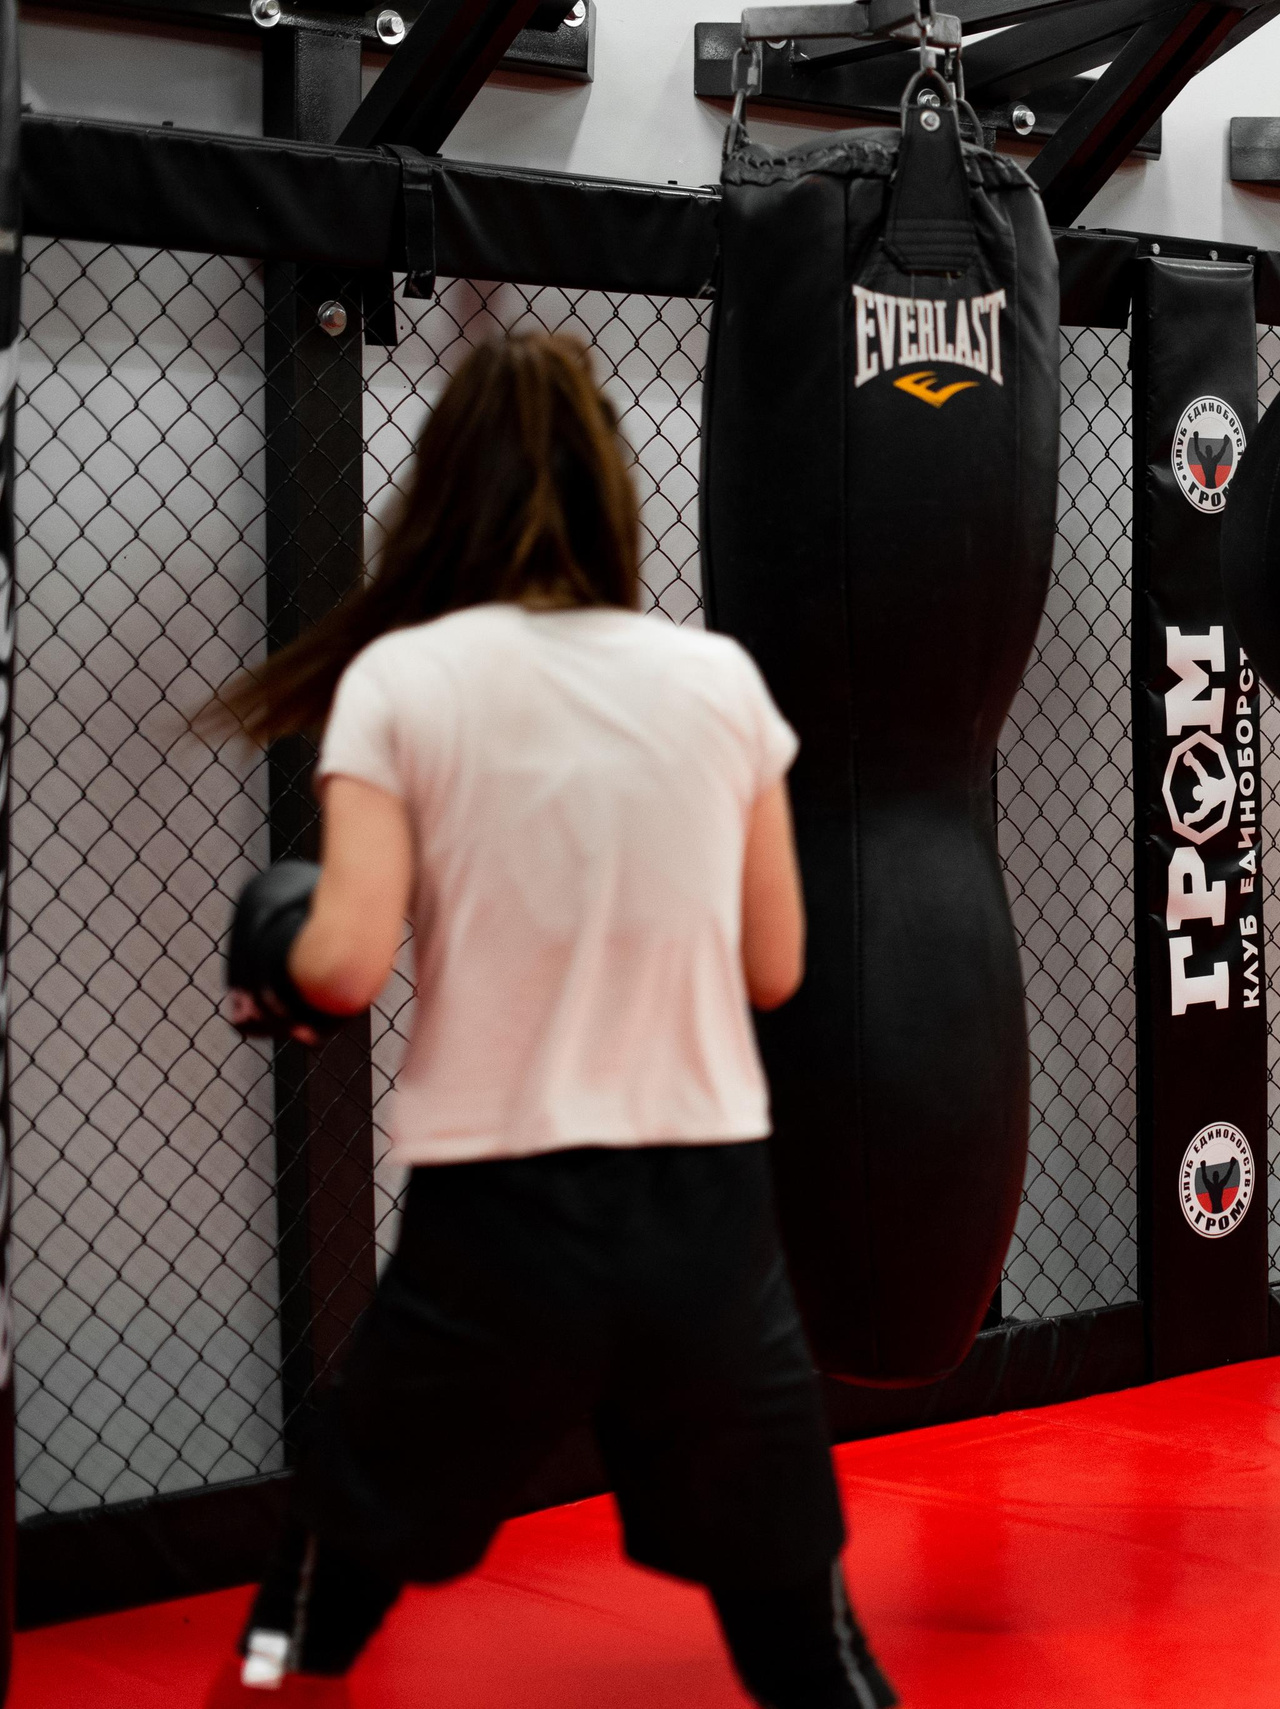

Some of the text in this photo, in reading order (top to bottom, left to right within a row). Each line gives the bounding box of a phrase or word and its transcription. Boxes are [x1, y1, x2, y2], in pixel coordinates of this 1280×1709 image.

[852, 284, 1006, 388] EVERLAST
[1175, 402, 1245, 471] КЛУБ ЕДИНОБОРСТ
[1235, 647, 1260, 1009] КЛУБ ЕДИНОБОРСТ
[1183, 1128, 1251, 1203] КЛУБ ЕДИНОБОРСТВ
[1194, 1199, 1246, 1231] ГРОМ
